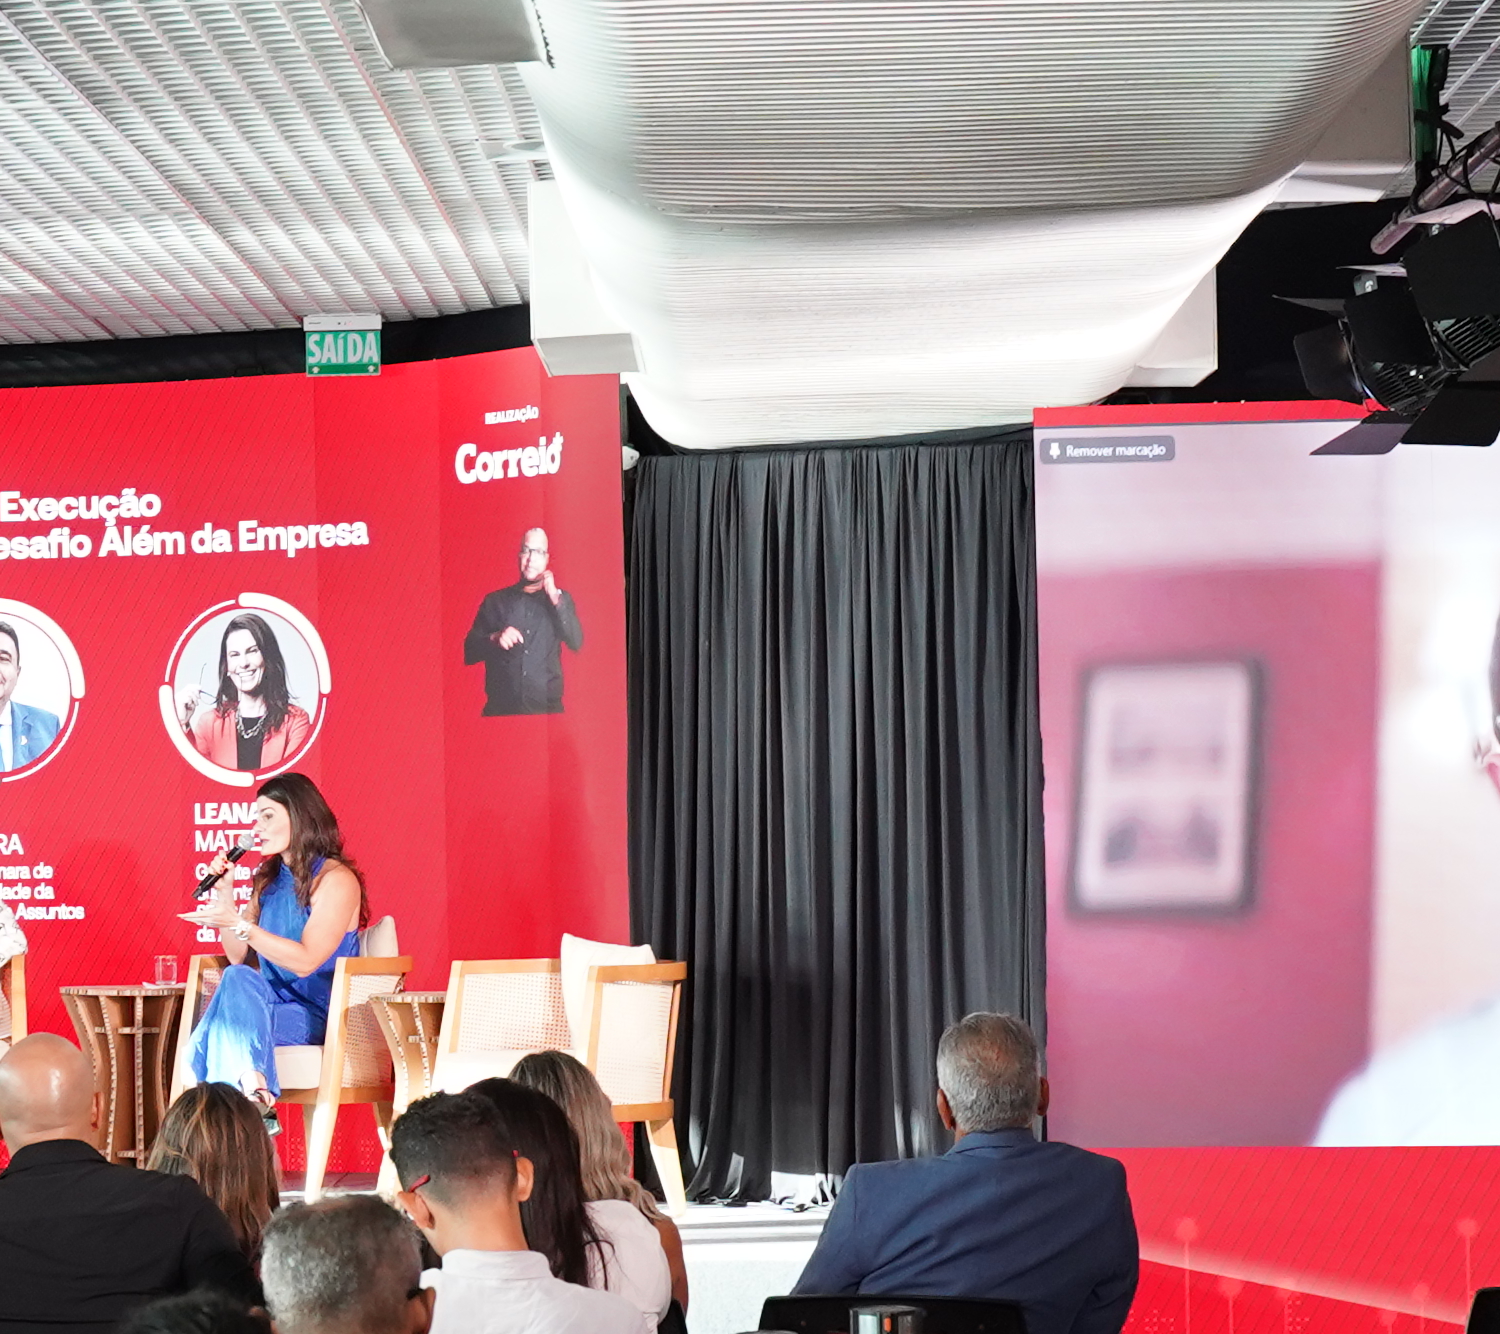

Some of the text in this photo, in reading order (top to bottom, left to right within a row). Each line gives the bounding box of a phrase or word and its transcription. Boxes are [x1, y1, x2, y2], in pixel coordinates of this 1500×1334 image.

[308, 332, 379, 364] SAÍDA
[484, 404, 539, 424] REALIZAÇÃO
[1065, 444, 1113, 458] Remover
[0, 487, 162, 527] Execução
[98, 524, 186, 557] Além
[191, 521, 233, 554] da
[238, 519, 370, 558] Empresa
[32, 861, 54, 879] de
[33, 881, 56, 900] da
[14, 902, 85, 920] Assuntos
